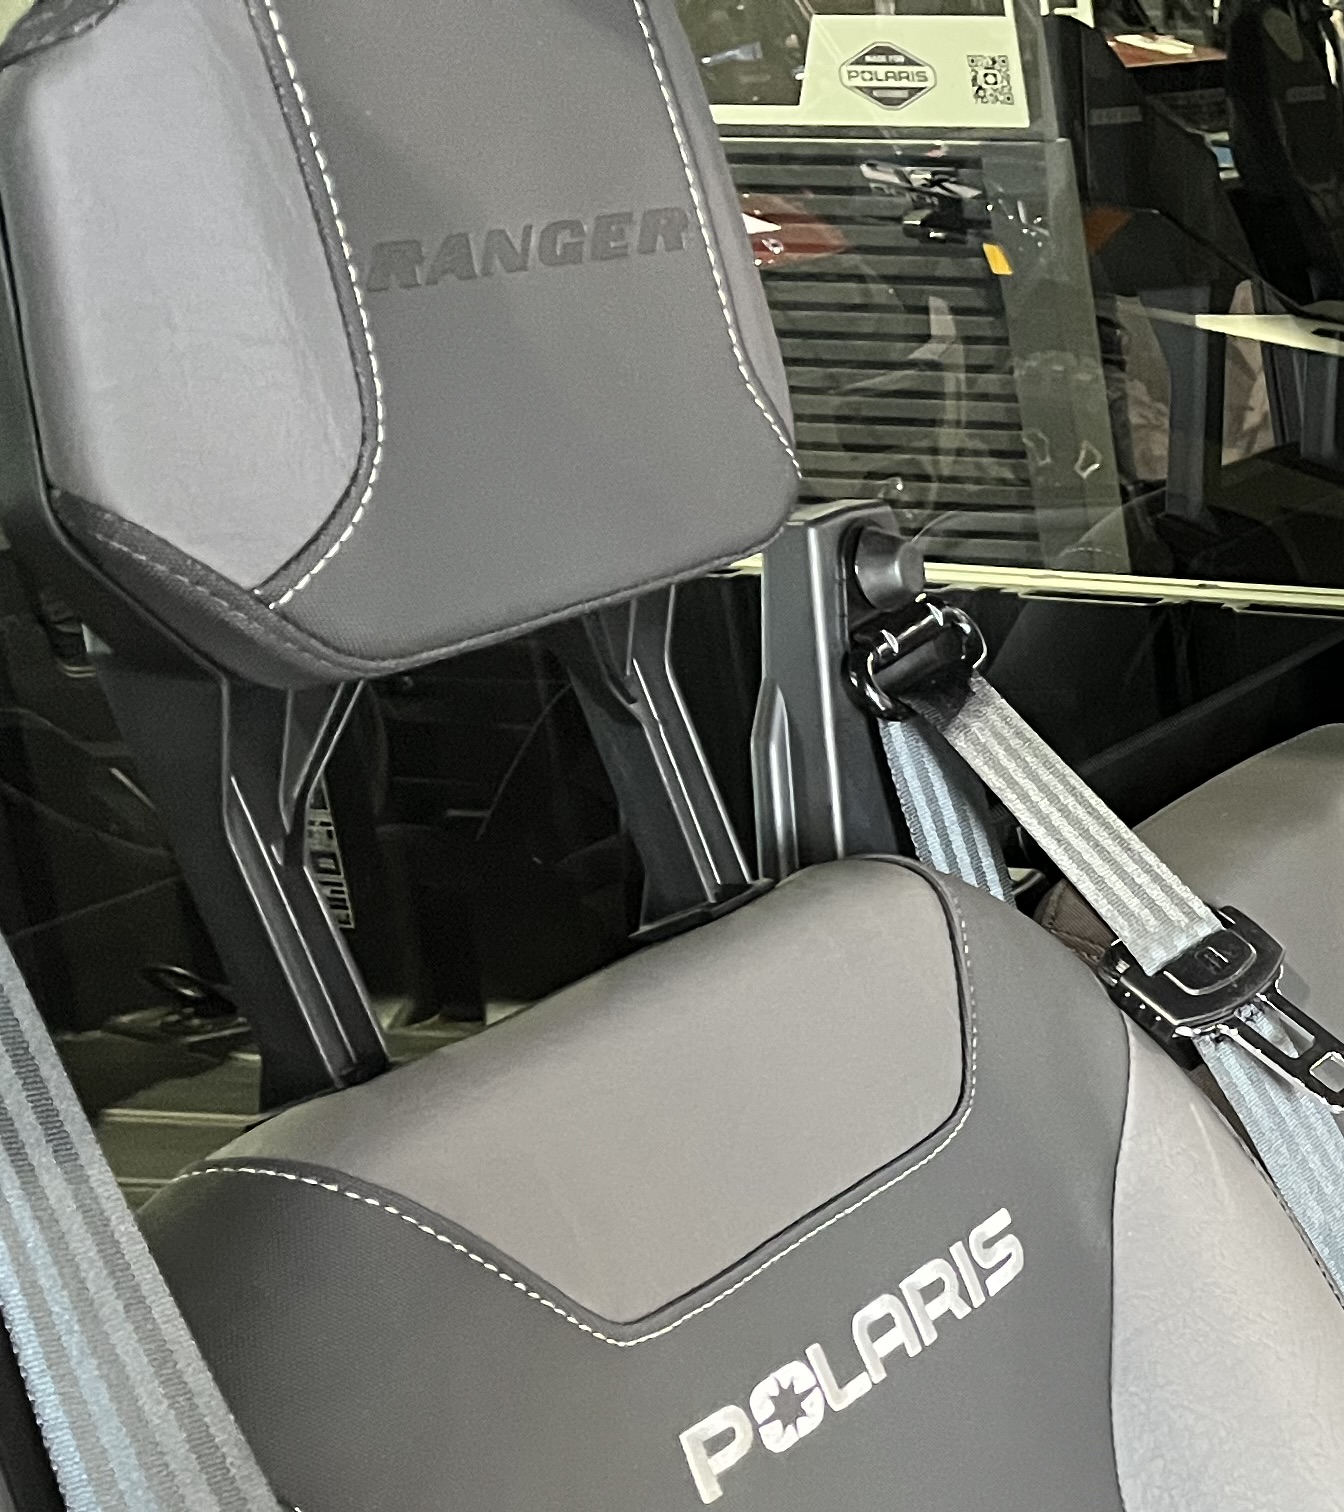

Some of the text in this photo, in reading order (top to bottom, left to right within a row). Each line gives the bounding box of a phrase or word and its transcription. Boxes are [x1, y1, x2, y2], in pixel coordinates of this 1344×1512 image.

[847, 70, 929, 83] POLARIS
[366, 206, 690, 293] RANGER
[679, 1207, 1025, 1505] POLARIS
